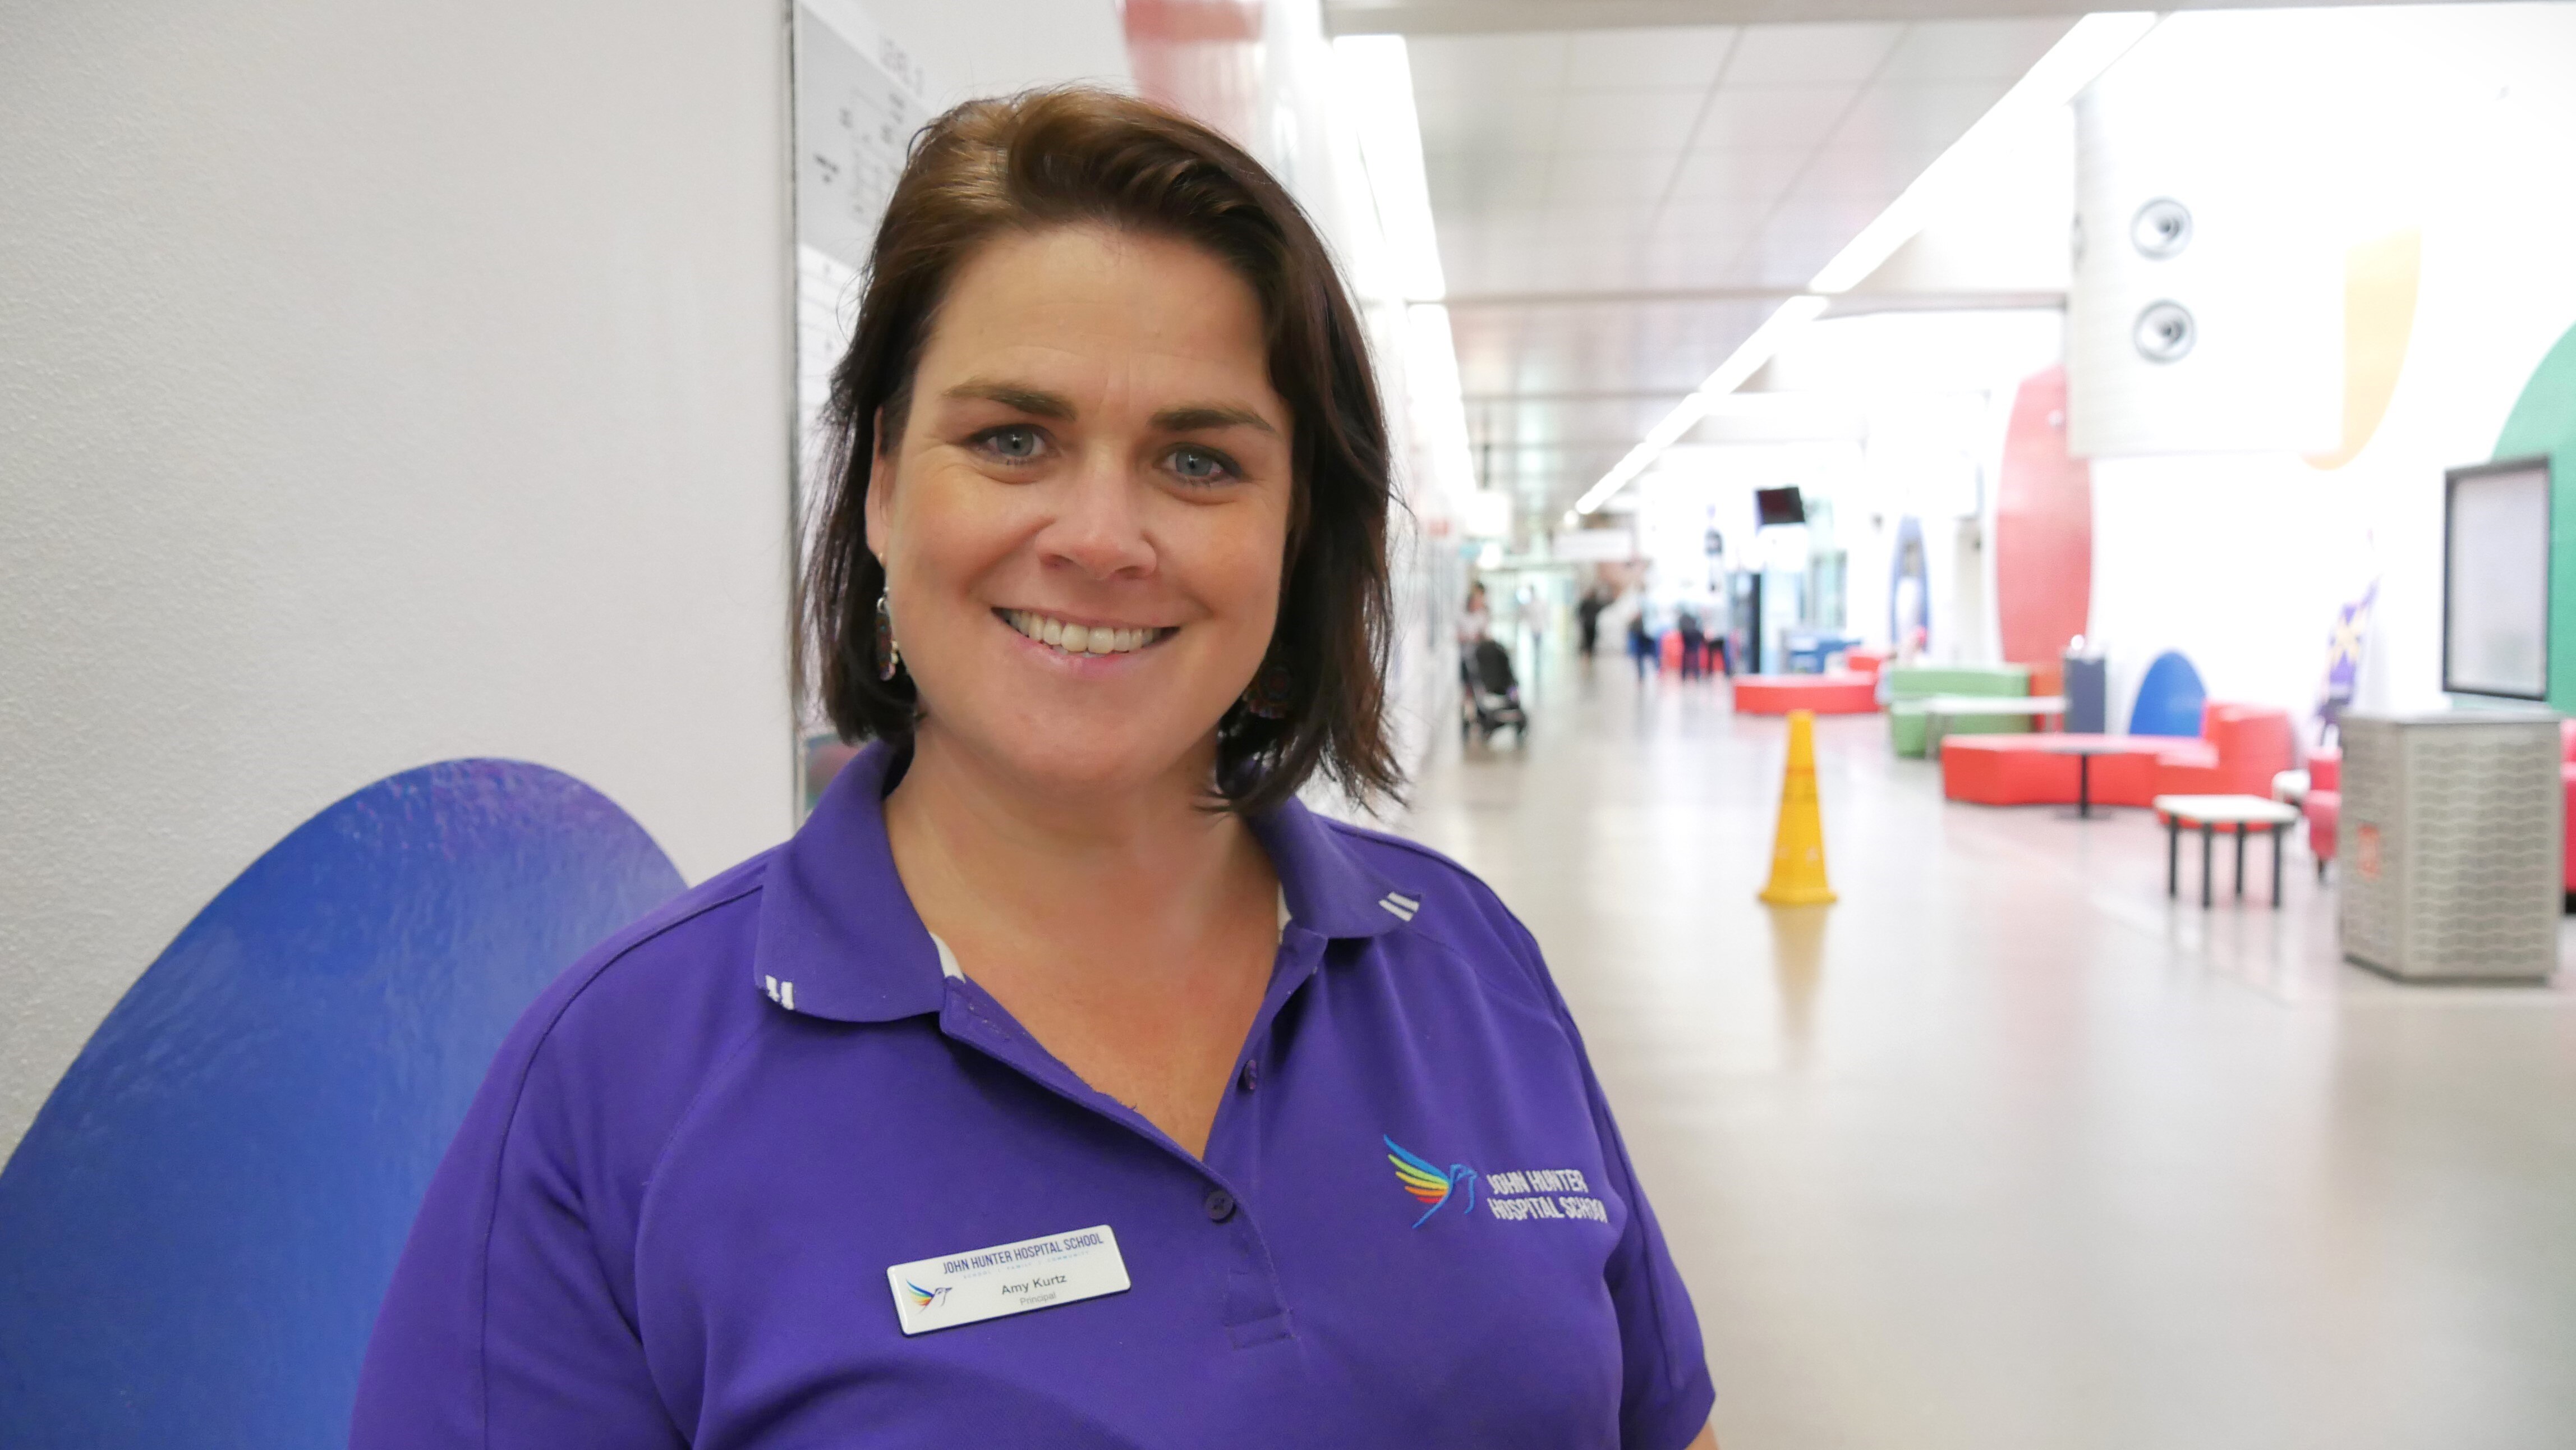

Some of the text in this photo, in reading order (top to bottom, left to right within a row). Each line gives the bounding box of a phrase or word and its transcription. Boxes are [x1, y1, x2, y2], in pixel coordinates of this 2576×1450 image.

[1486, 1169, 1589, 1195] JOHN HUNTER
[1487, 1196, 1565, 1221] HOSPITAL
[944, 1232, 1103, 1274] JOHN HUNTER HOSPITAL SCHOOL
[1001, 1274, 1067, 1295] Amy Kurtz
[1020, 1292, 1056, 1306] Principal
